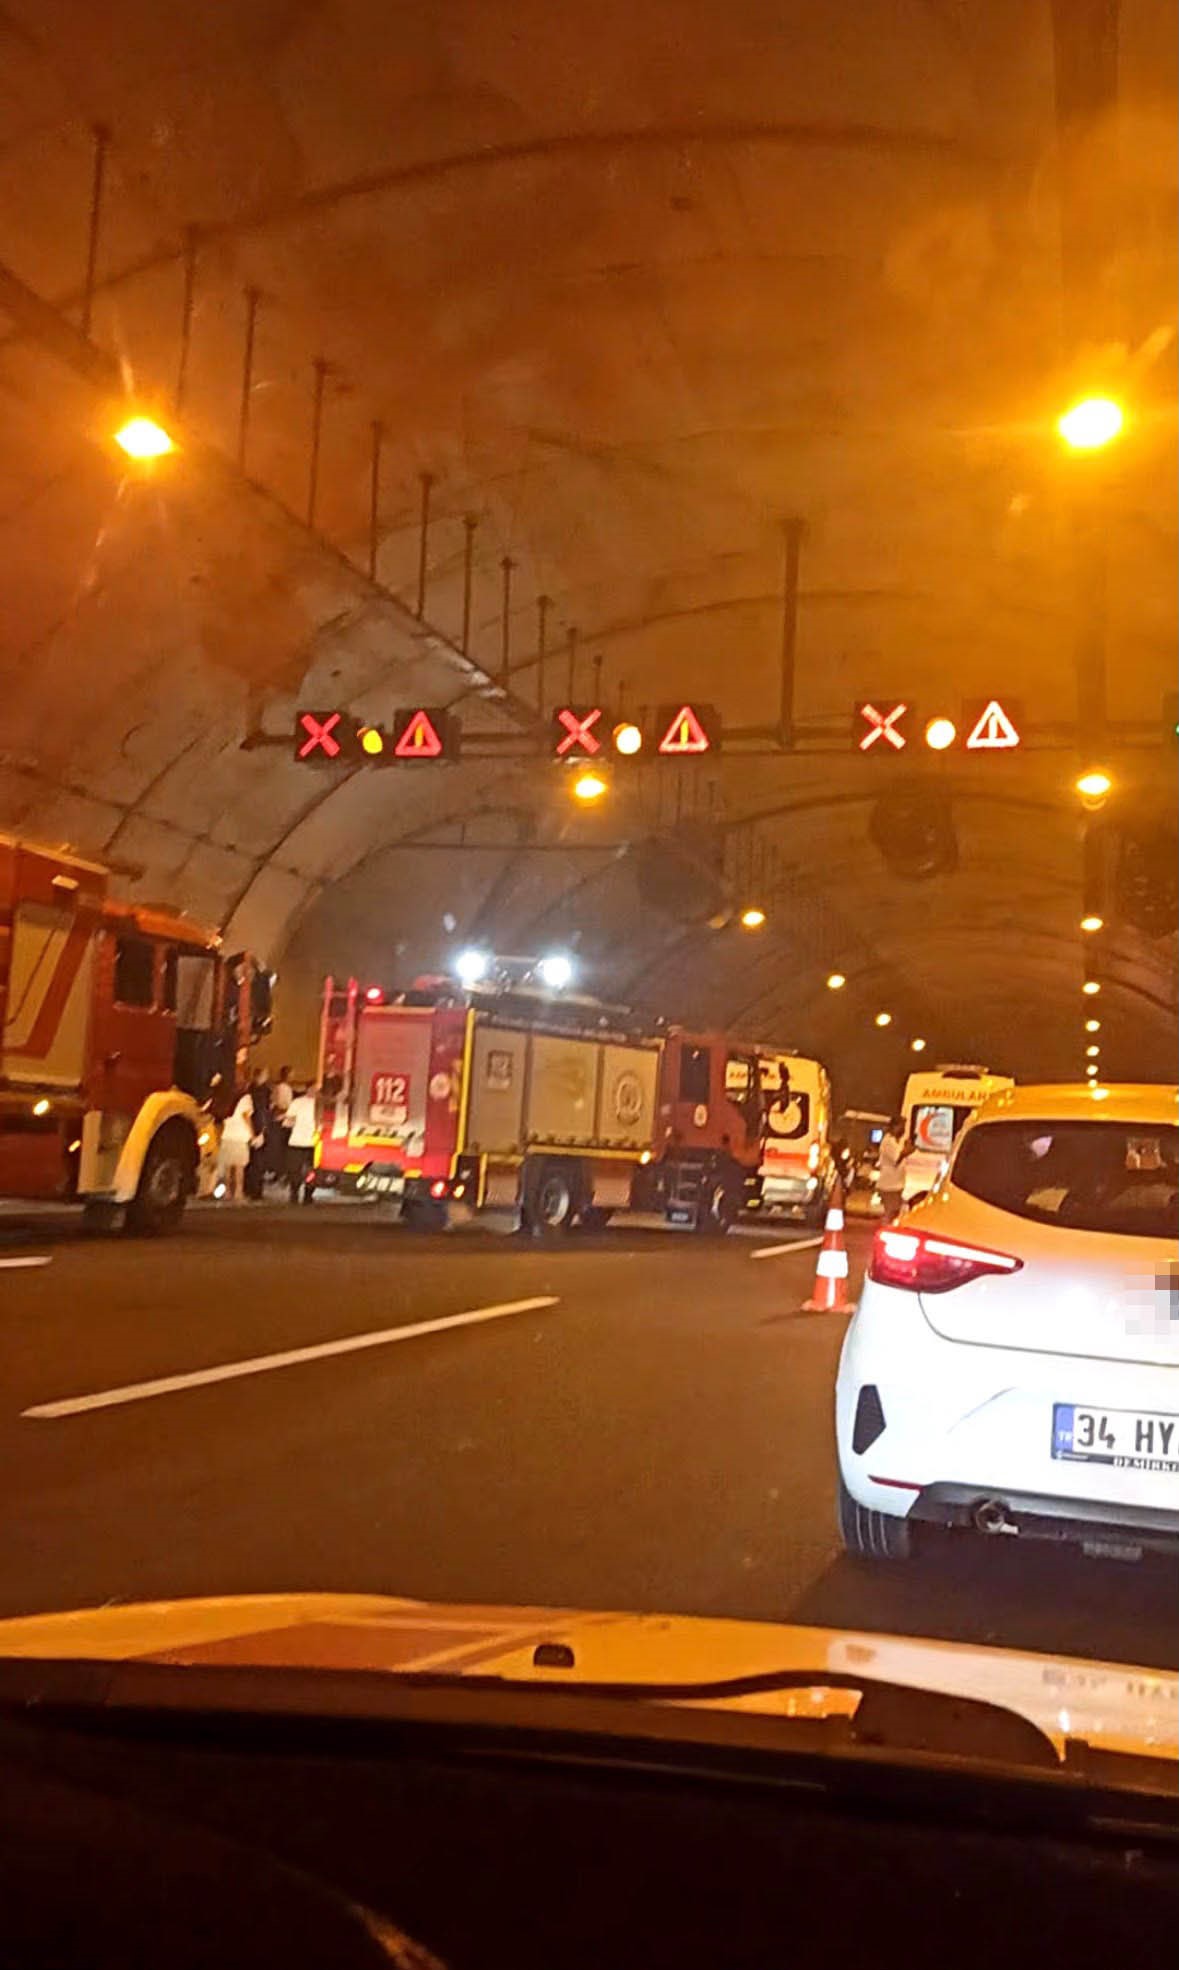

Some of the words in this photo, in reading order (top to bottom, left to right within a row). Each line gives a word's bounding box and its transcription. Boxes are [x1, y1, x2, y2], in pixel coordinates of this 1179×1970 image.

[375, 1077, 406, 1104] 112
[922, 1087, 989, 1101] AMBULAN
[1077, 1413, 1117, 1450] 34
[1135, 1419, 1179, 1455] HY
